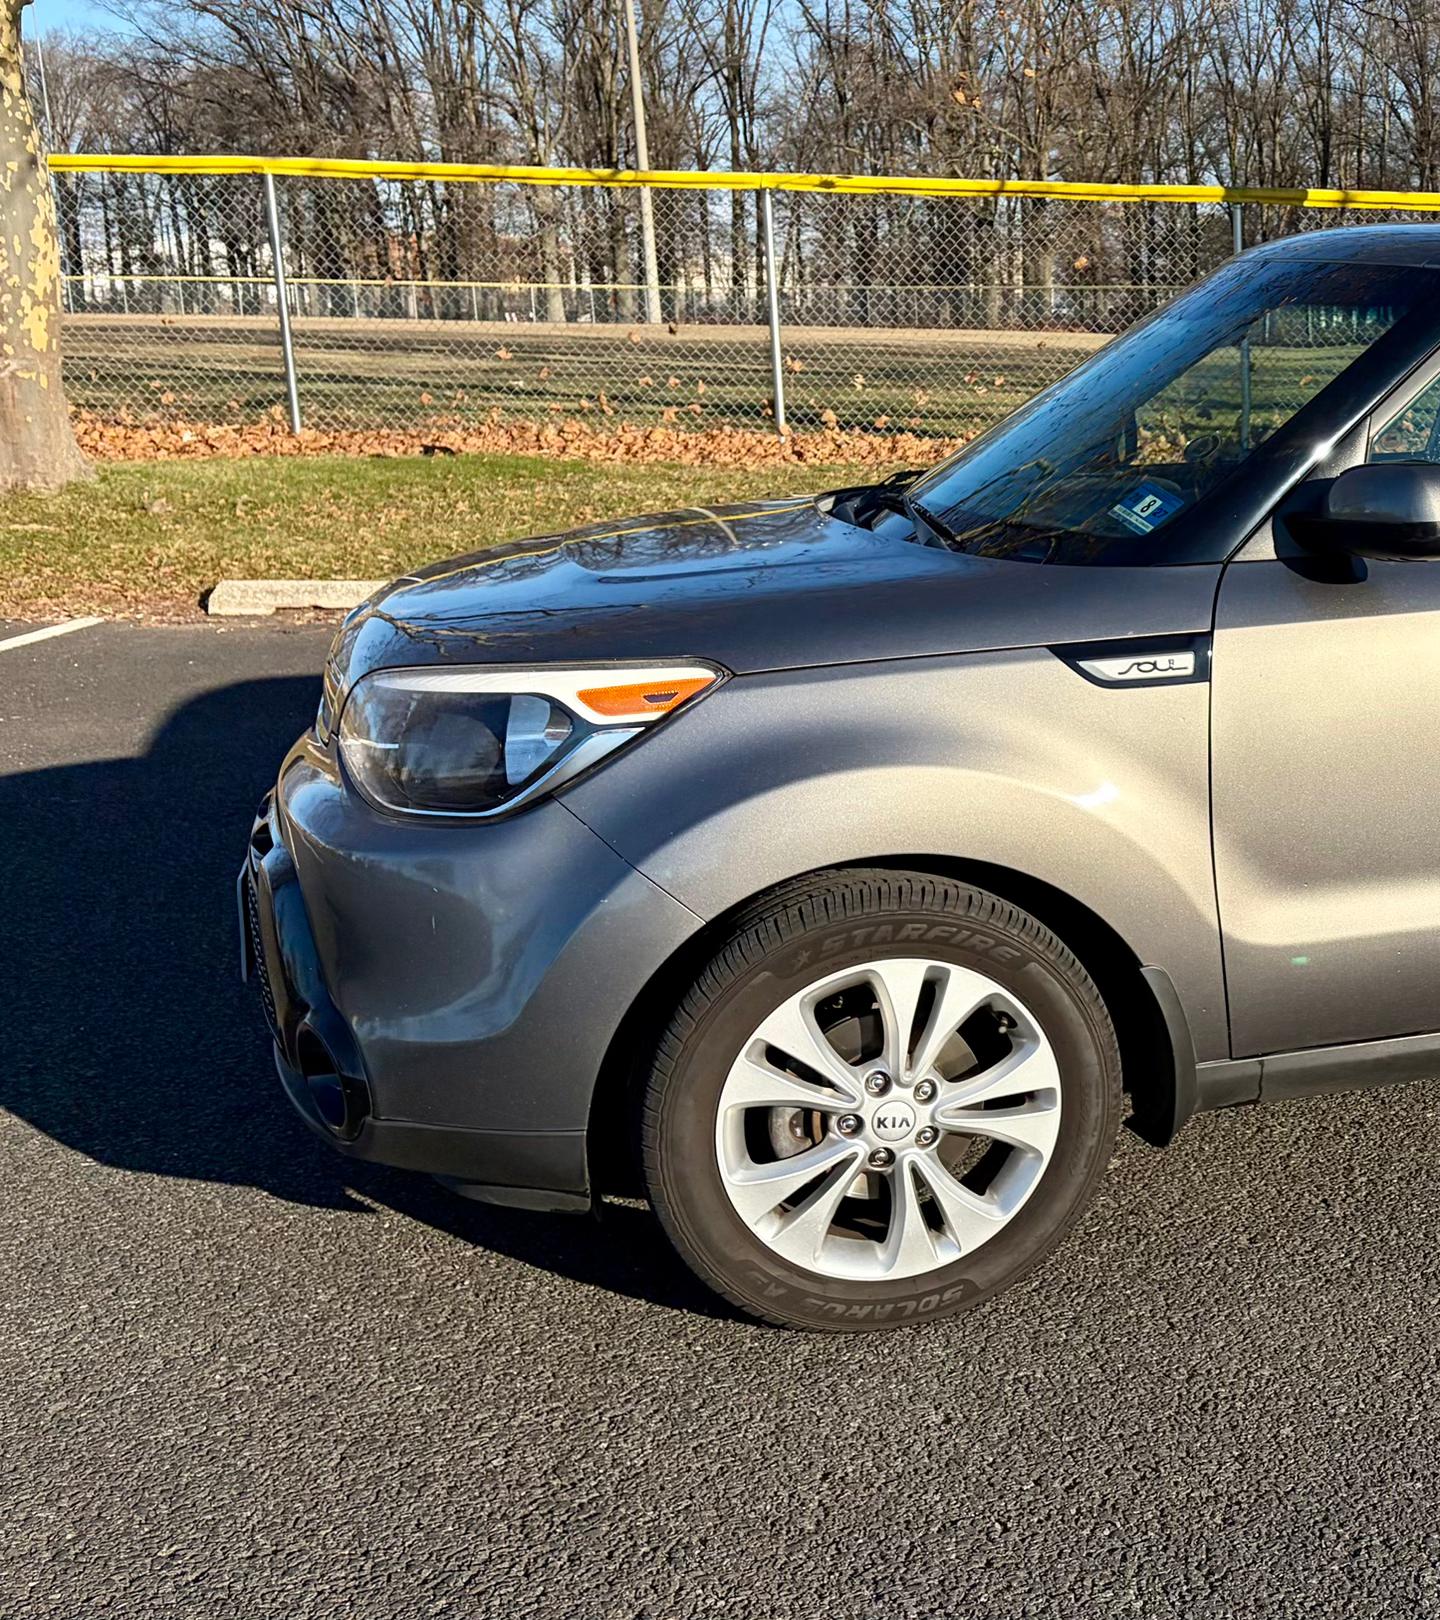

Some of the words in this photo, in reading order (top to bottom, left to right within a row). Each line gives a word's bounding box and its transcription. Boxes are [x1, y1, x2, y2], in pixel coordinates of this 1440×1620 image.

[1140, 499, 1157, 513] 8
[819, 922, 1022, 963] STARFIRE
[876, 1116, 911, 1129] KIA
